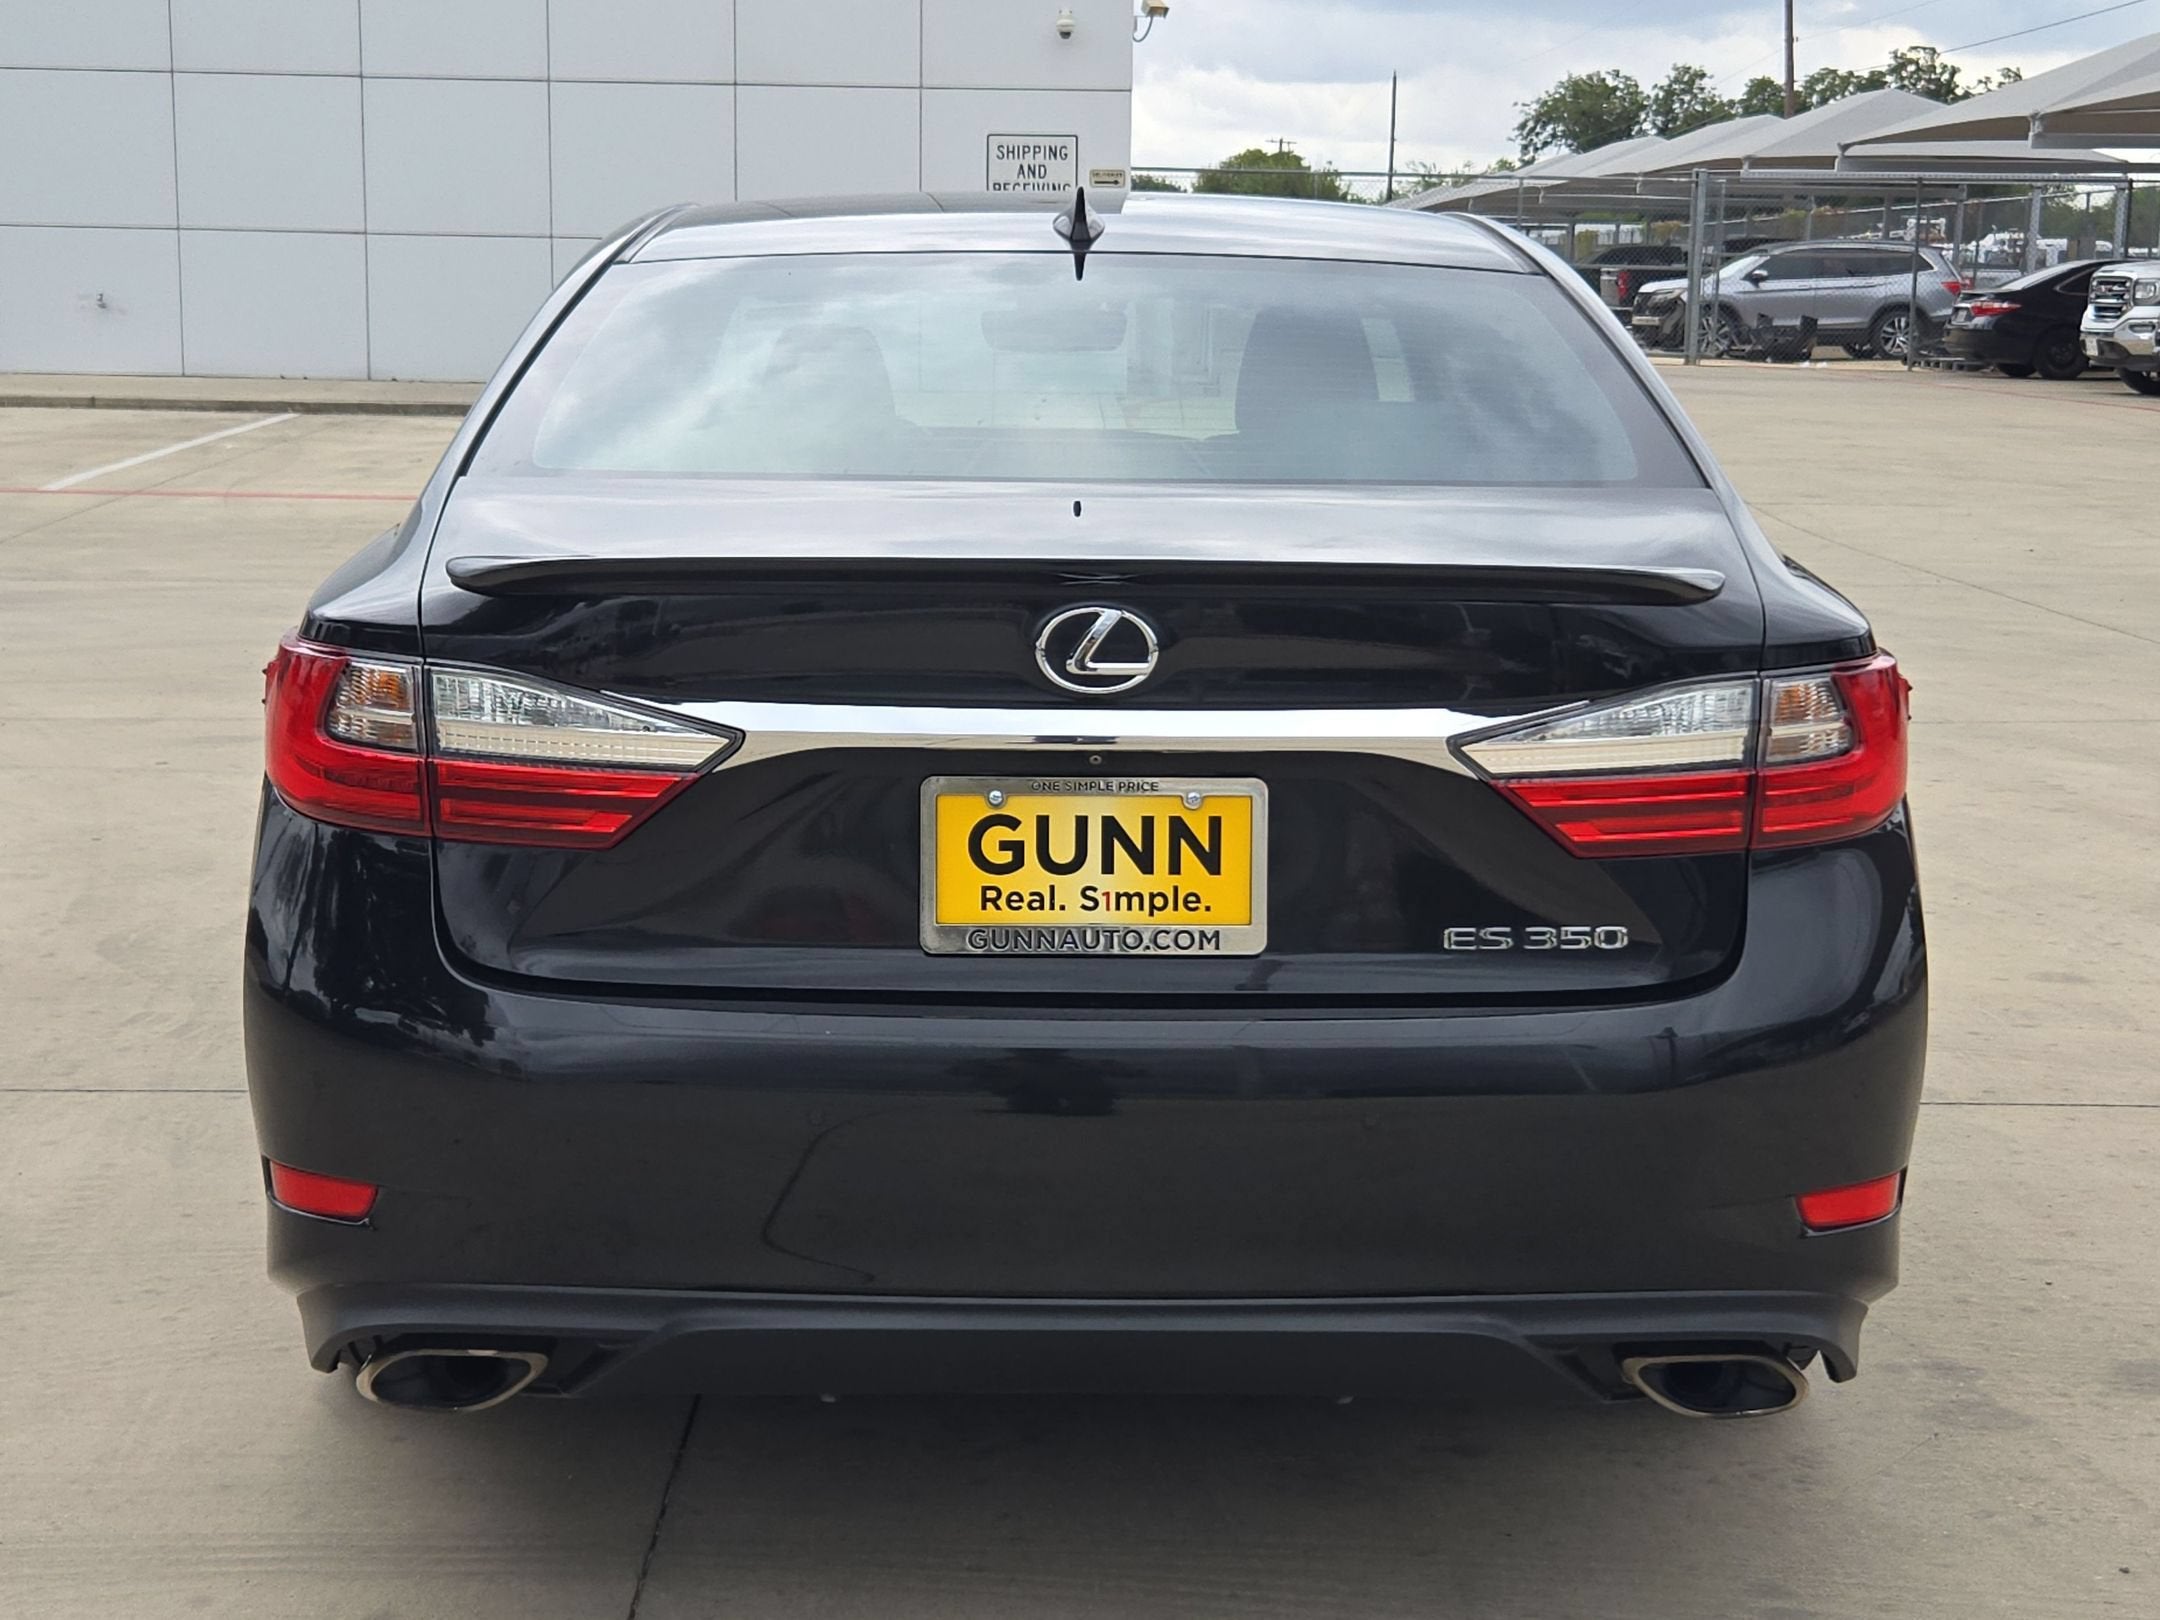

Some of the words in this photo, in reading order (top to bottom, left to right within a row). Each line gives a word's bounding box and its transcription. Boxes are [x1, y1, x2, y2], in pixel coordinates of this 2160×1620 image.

[996, 145, 1068, 161] SHIPPING
[1017, 164, 1047, 179] AND
[1031, 781, 1060, 791] ONE
[1065, 781, 1114, 792] SIMPLE
[1118, 781, 1160, 792] PRICE
[967, 813, 1222, 876] GUNN
[980, 884, 1066, 912] Real.
[967, 928, 1221, 951] GUNNAUTO.COM
[1443, 926, 1514, 950] ES
[1523, 926, 1629, 950] 350
